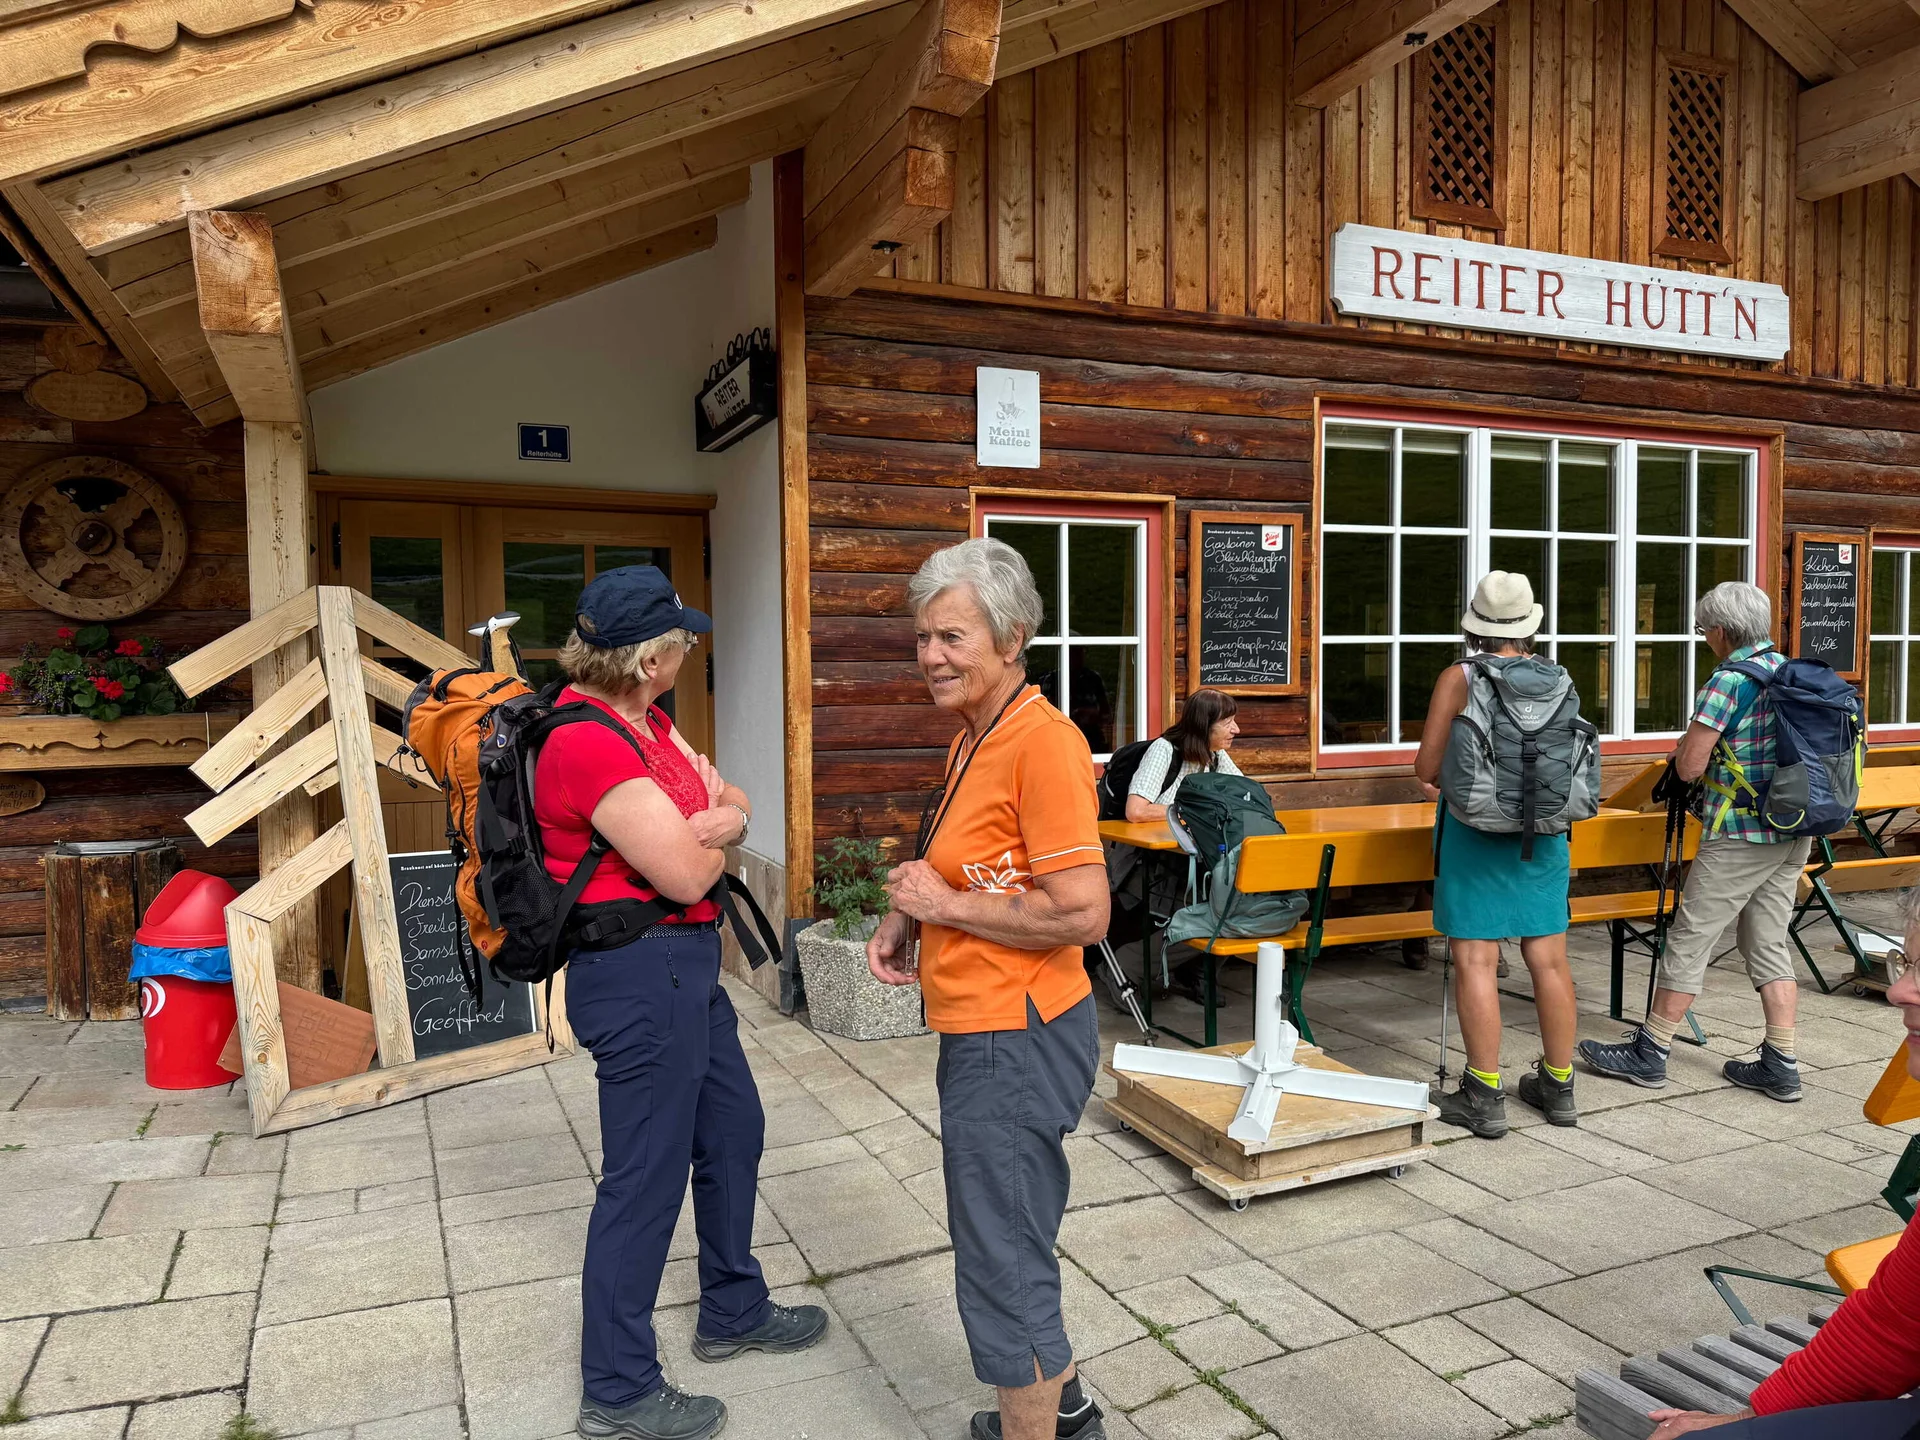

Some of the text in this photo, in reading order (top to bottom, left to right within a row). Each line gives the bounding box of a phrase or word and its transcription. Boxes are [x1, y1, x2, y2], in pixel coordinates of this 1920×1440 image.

[1372, 246, 1758, 342] REITER HÜTT'N
[714, 377, 741, 407] REITER
[538, 429, 547, 448] 1
[989, 426, 1031, 438] Meinl
[989, 435, 1031, 447] Kaffee
[527, 450, 562, 458] Reiterhütte
[1204, 536, 1256, 557] Gasteiner
[1207, 561, 1277, 574] mit Sauerkraut
[1215, 550, 1287, 570] Fleischkrapfen
[1802, 554, 1839, 572] Kuchen
[1226, 573, 1259, 585] 14,50€
[1204, 606, 1280, 620] Knödel und Kraut
[1220, 602, 1238, 610] mit
[1223, 619, 1259, 630] 18,20€
[1202, 636, 1270, 655] Bauernkrapfen
[1811, 635, 1838, 654] 4,50€
[1219, 649, 1238, 658] mit
[1261, 659, 1285, 674] 9,20€
[1204, 673, 1233, 683] Küche
[1235, 674, 1247, 683] bis
[1248, 674, 1258, 683] 15
[400, 881, 455, 914] Dienst
[413, 997, 505, 1036] Geöffnet
